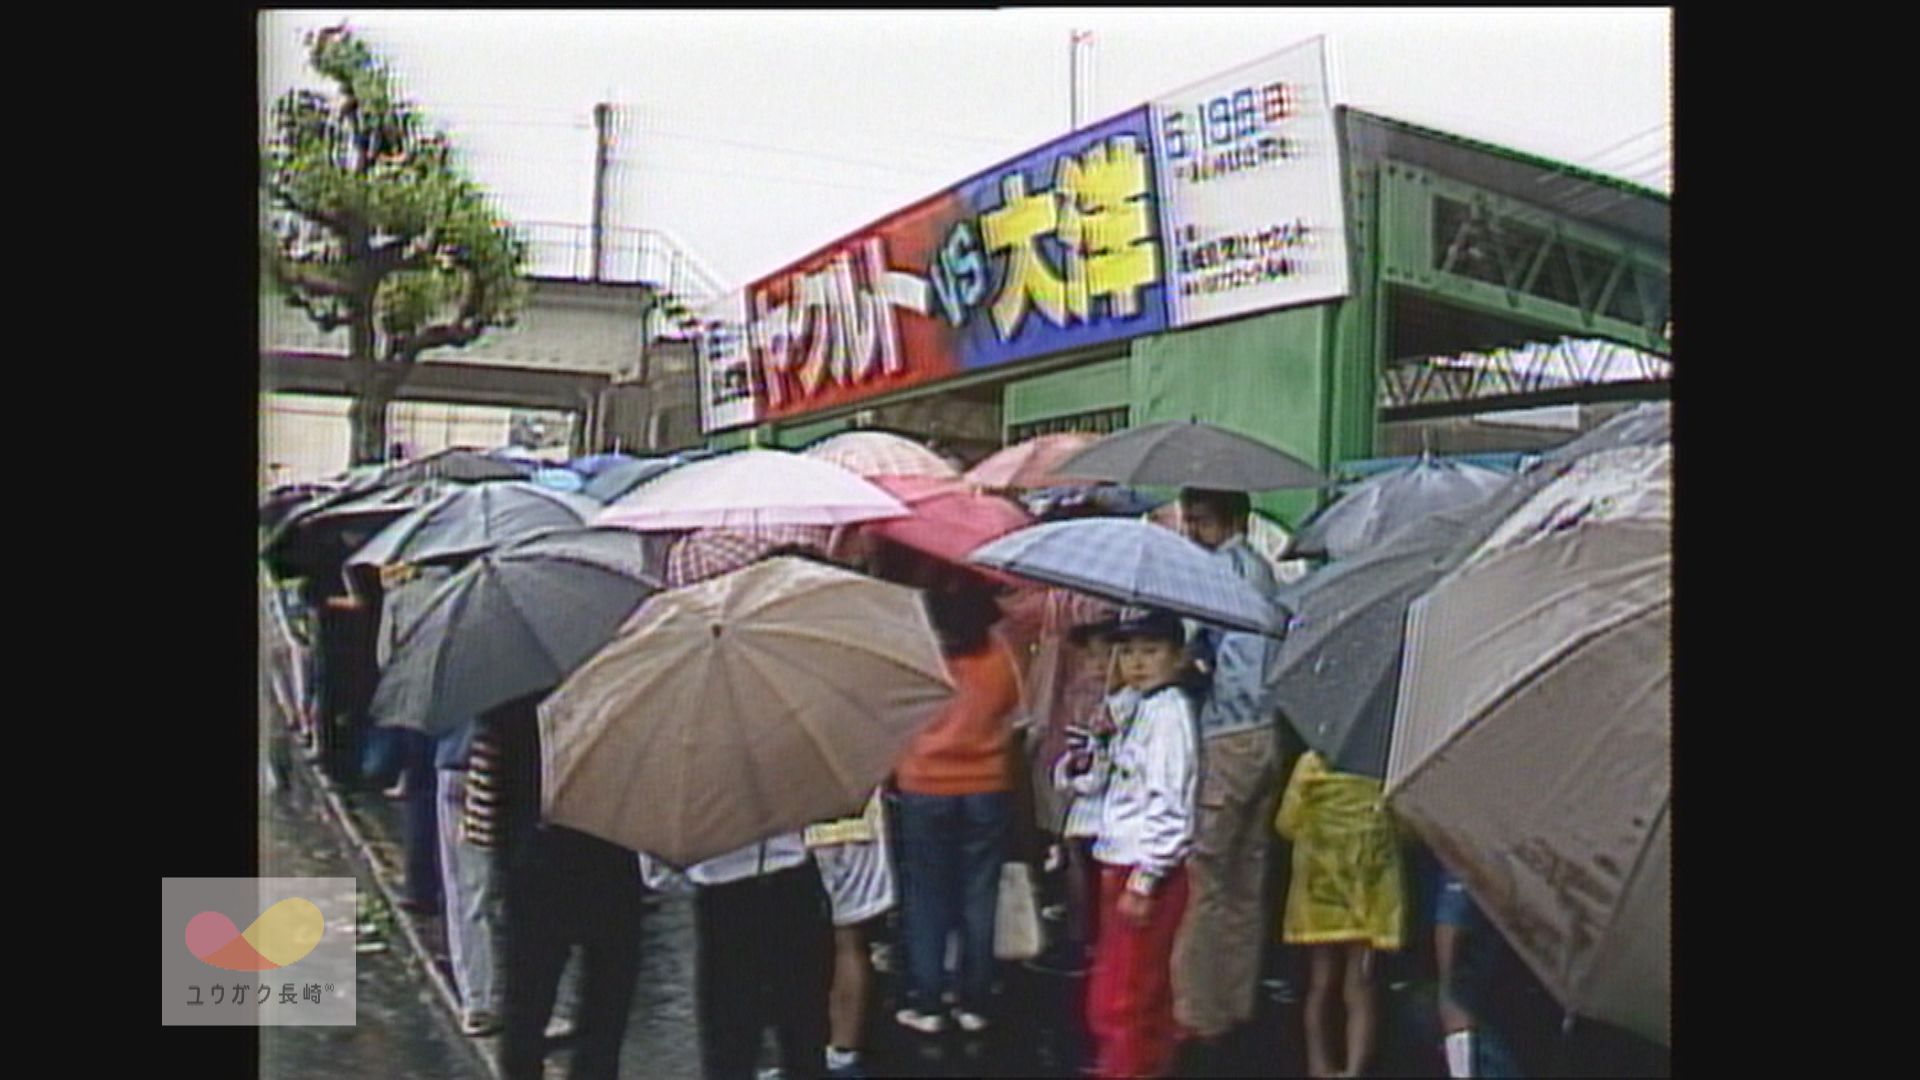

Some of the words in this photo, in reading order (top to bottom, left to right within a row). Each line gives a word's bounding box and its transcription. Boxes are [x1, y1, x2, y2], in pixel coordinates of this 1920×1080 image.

[747, 236, 930, 407] ヤクルト
[980, 134, 1160, 343] 大洋
